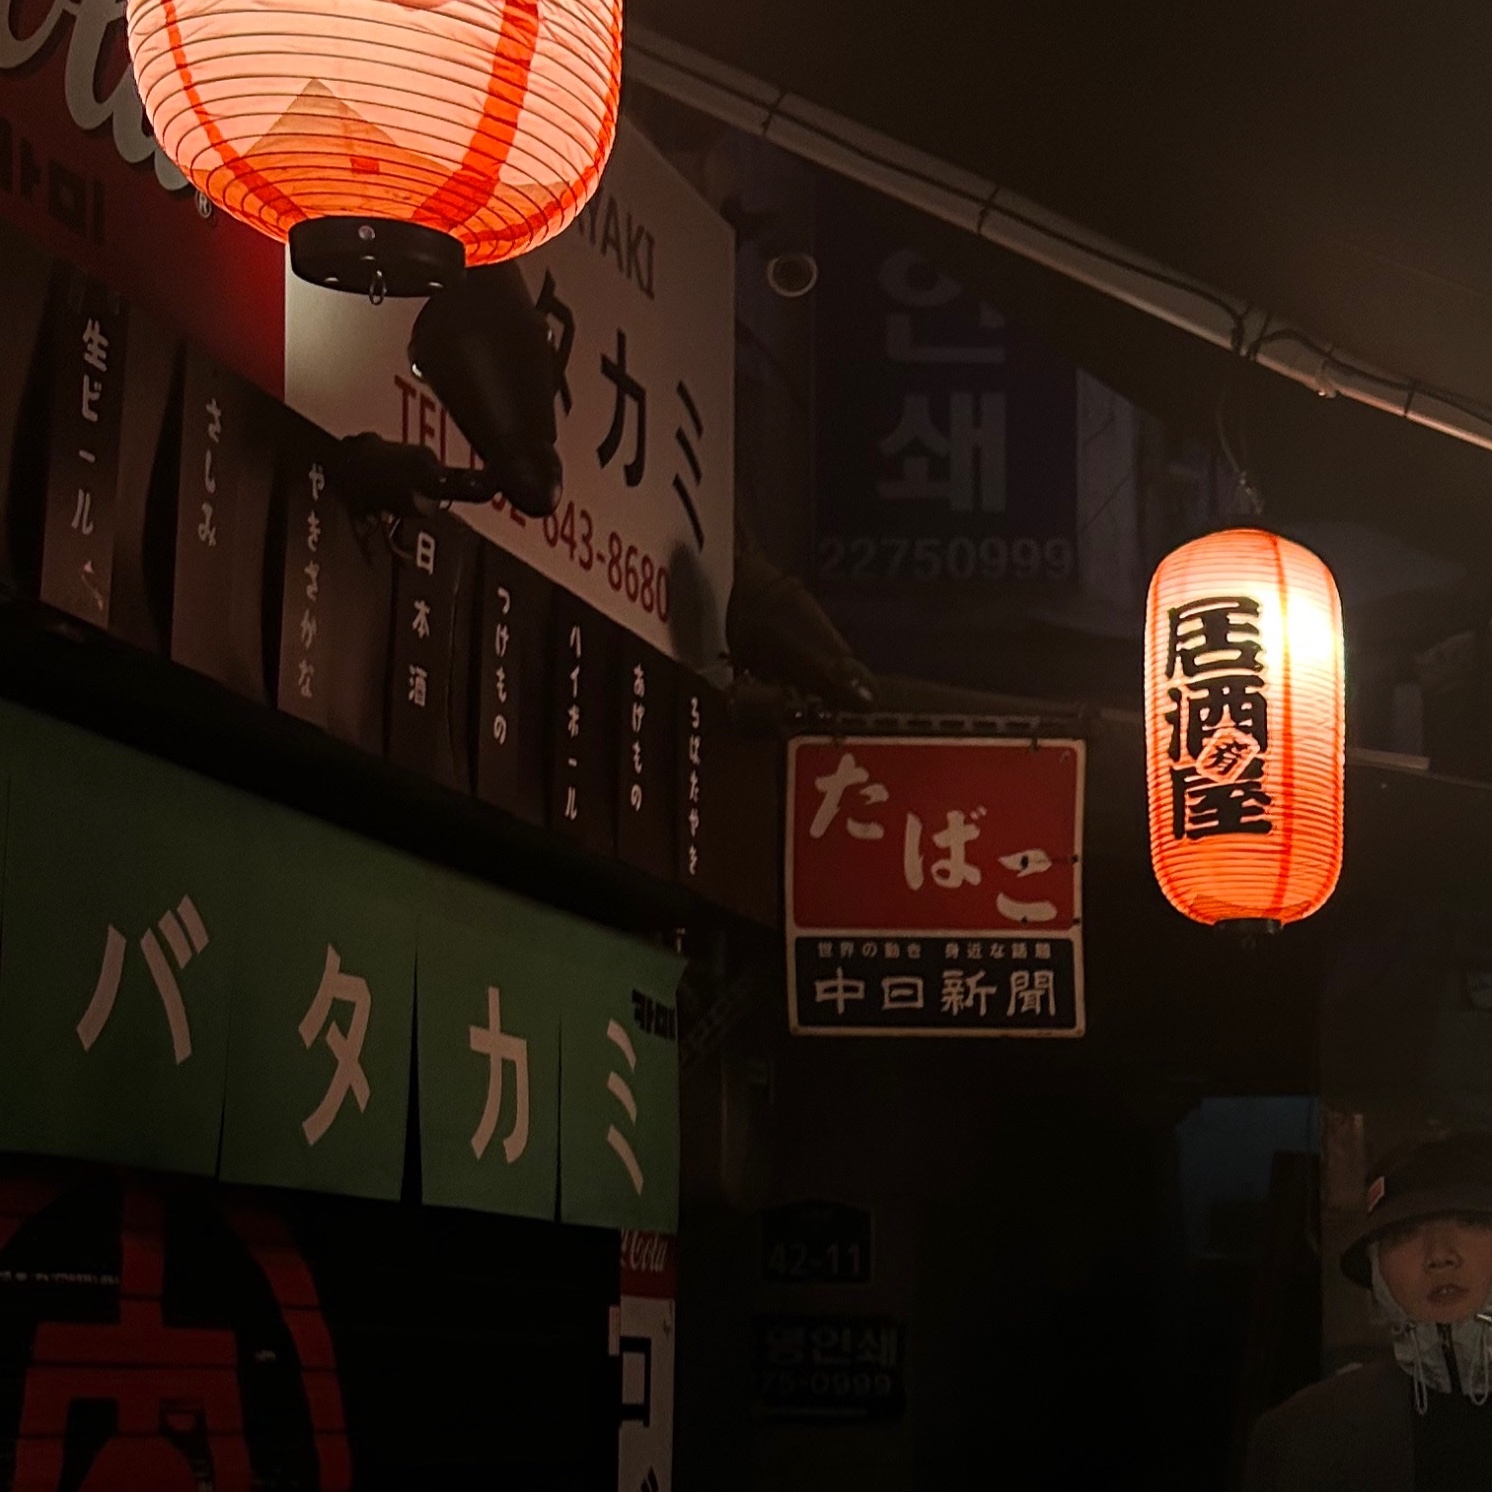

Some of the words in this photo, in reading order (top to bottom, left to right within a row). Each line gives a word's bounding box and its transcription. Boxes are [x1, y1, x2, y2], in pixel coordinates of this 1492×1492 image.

[70, 317, 110, 536] 生ビール
[197, 397, 223, 548] さしみ
[408, 530, 438, 708] 日本酒
[818, 538, 1076, 581] 22750999
[493, 585, 511, 745] つけもの
[1165, 596, 1272, 841] 居酒屋
[808, 752, 1059, 923] たばこ
[813, 965, 1057, 1018] 中日新聞
